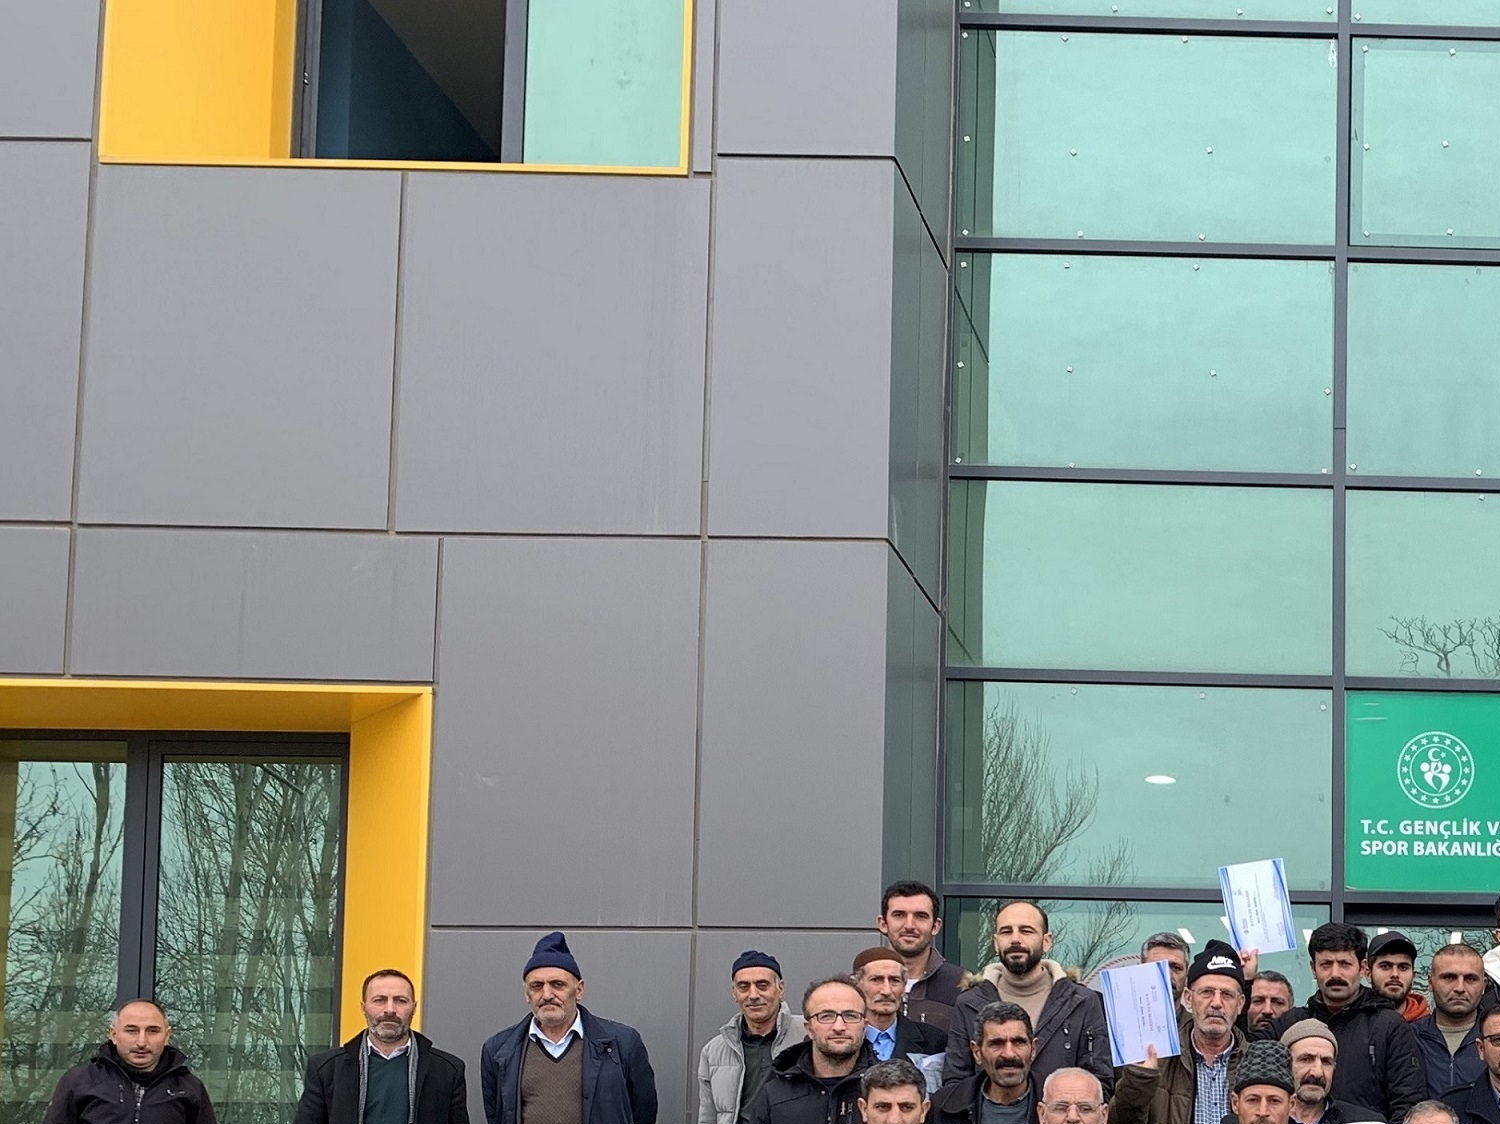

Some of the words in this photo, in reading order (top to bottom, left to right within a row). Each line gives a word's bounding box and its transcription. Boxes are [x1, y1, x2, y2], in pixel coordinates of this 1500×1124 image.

[1361, 820, 1394, 835] T.C.
[1400, 818, 1481, 839] GENÇLİK
[1361, 841, 1409, 856] SPOR
